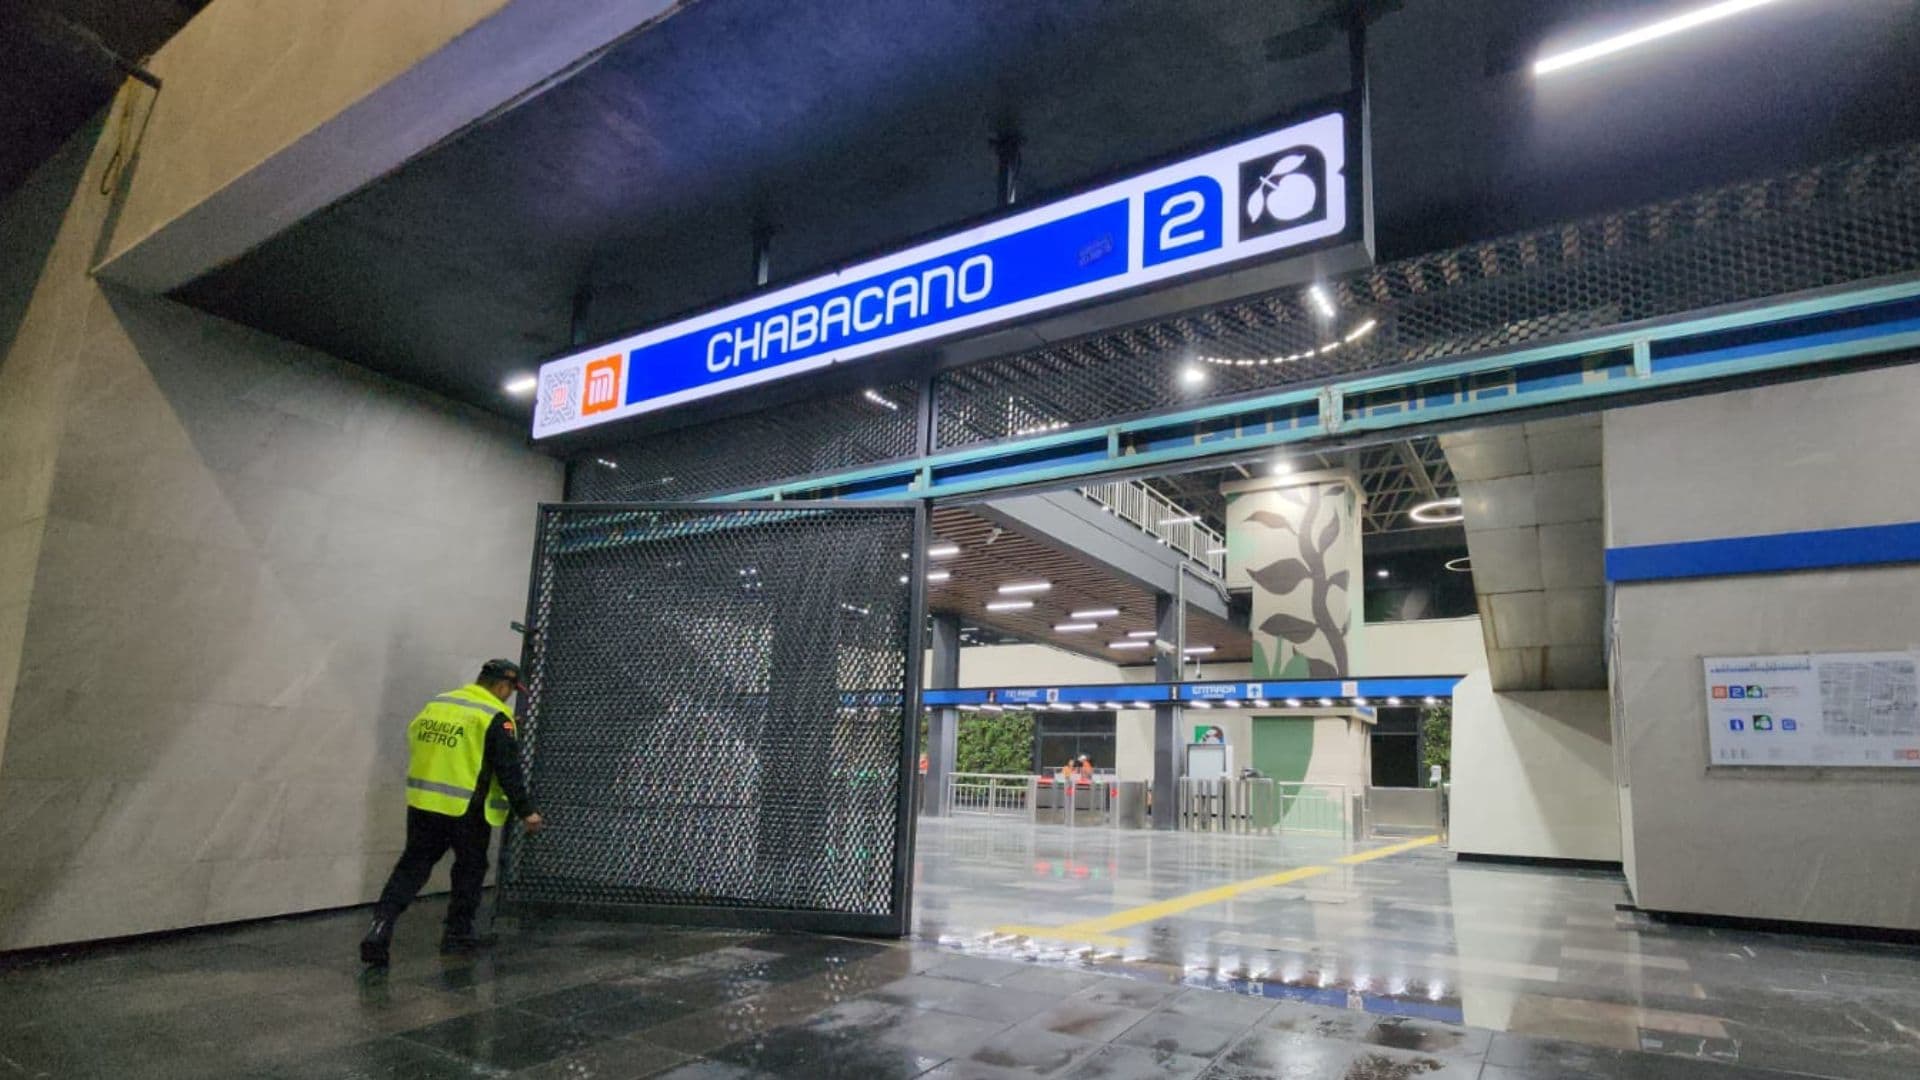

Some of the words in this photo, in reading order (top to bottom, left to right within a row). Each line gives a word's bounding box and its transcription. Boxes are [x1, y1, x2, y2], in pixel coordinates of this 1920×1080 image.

[1160, 190, 1205, 251] 2
[706, 254, 993, 372] CHABACANO
[417, 730, 457, 748] METRO
